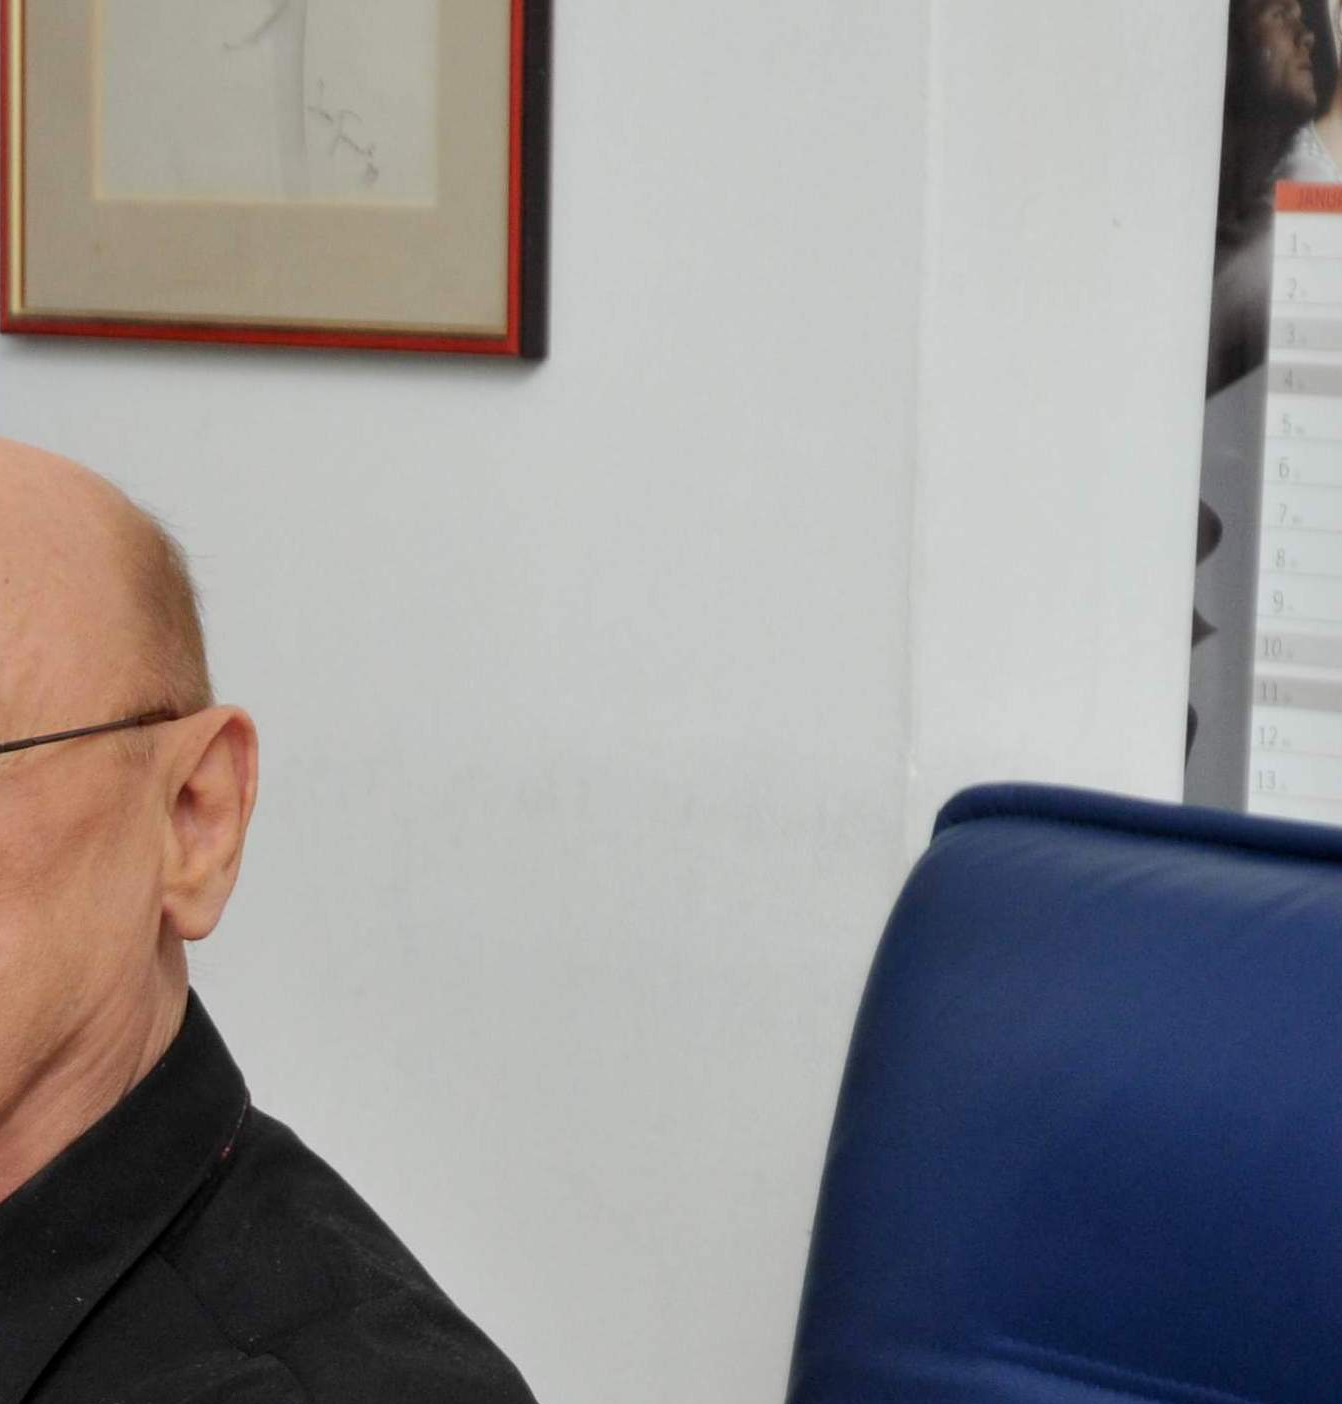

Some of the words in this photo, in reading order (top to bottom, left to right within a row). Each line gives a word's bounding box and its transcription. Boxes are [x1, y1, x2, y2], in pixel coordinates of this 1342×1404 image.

[1278, 456, 1290, 480] 6
[1278, 502, 1288, 524] 7
[1275, 547, 1286, 569] 8
[1272, 590, 1285, 614] 9
[1262, 635, 1282, 658] 10
[1260, 679, 1279, 702] 11
[1258, 725, 1278, 748] 12
[1256, 768, 1277, 791] 13
